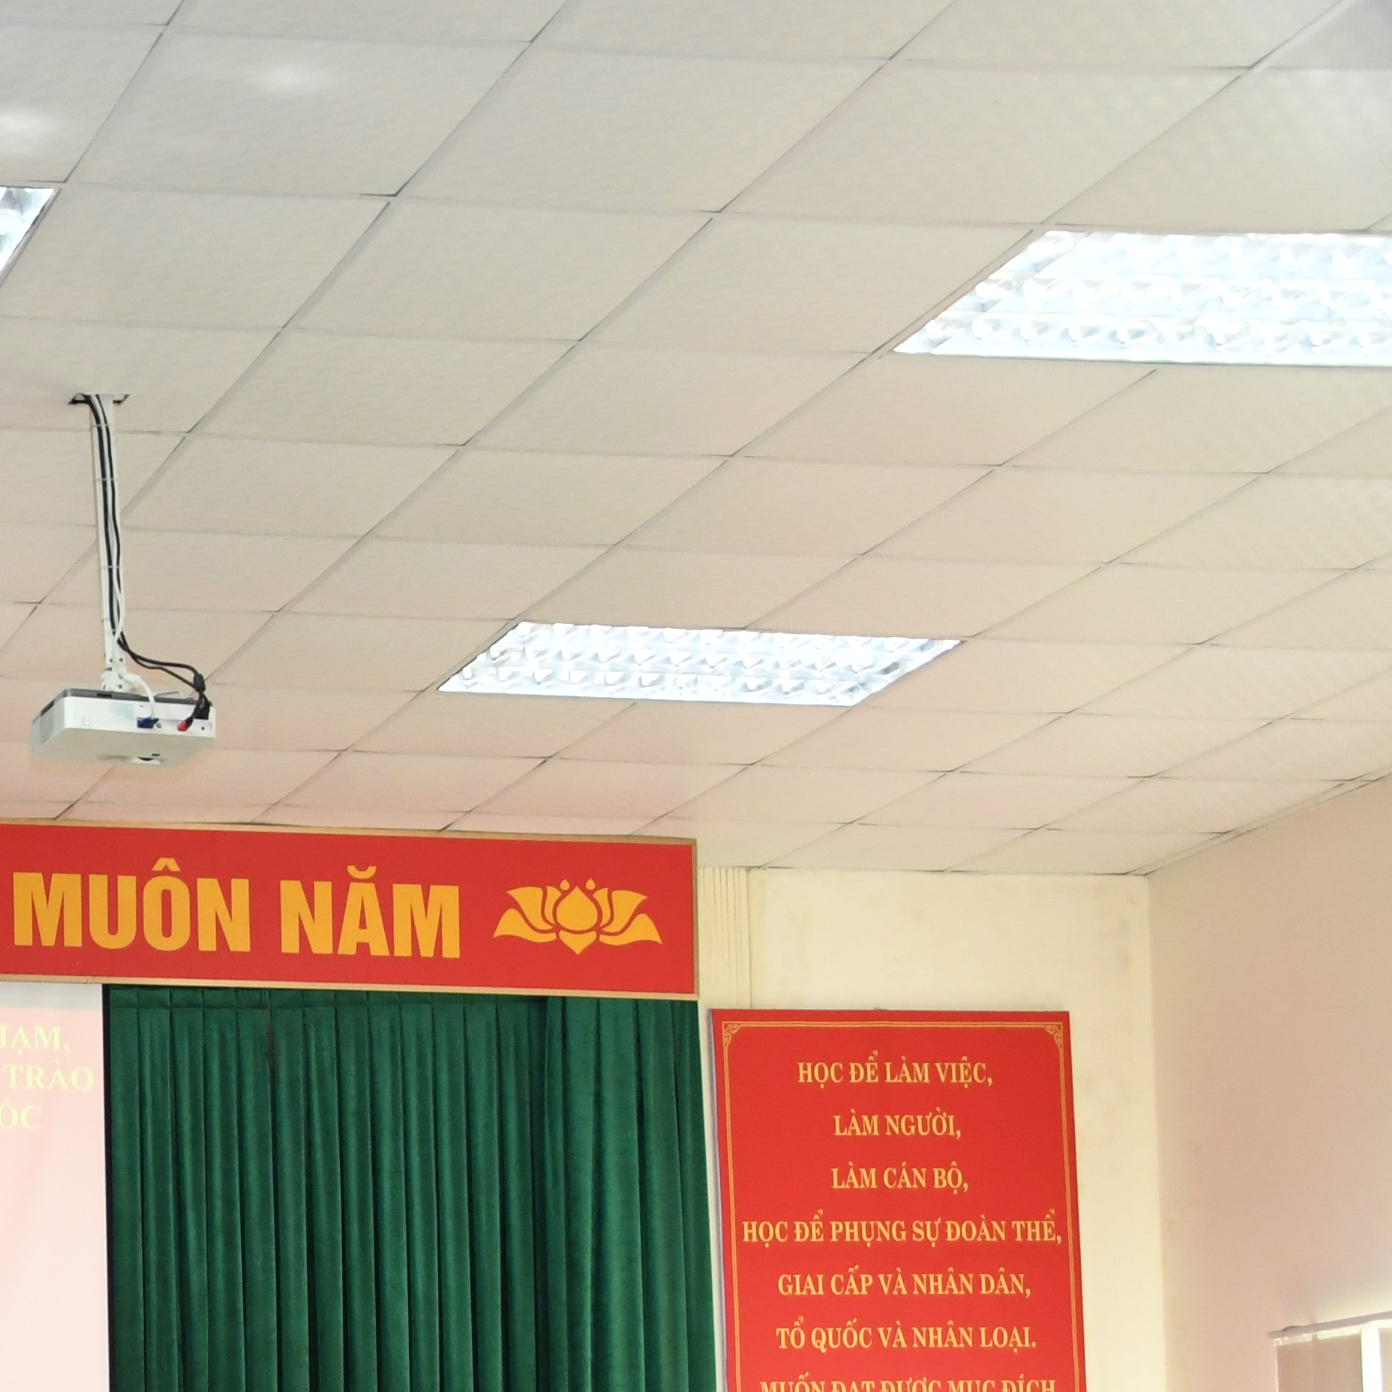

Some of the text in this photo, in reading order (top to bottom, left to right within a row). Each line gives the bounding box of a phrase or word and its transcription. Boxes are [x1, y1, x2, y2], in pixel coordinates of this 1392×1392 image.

[13, 858, 250, 952] MUÔN
[280, 865, 460, 958] NĂM
[798, 1051, 992, 1088] HỌC ĐỂ LÀM VIỆC,
[834, 1107, 961, 1139] LÀM NGƯỜI,
[832, 1161, 968, 1194] LÀM CÁN BỘ,
[743, 1209, 1061, 1248] HỌC ĐỂ PHỤNG SỰ ĐOÀN THỂ,
[778, 1265, 1030, 1298] GIAI CẤP VÀ NHÂN DÂN,
[776, 1317, 1036, 1353] TỔ QUỐC VÀ NHÂN LOẠI.
